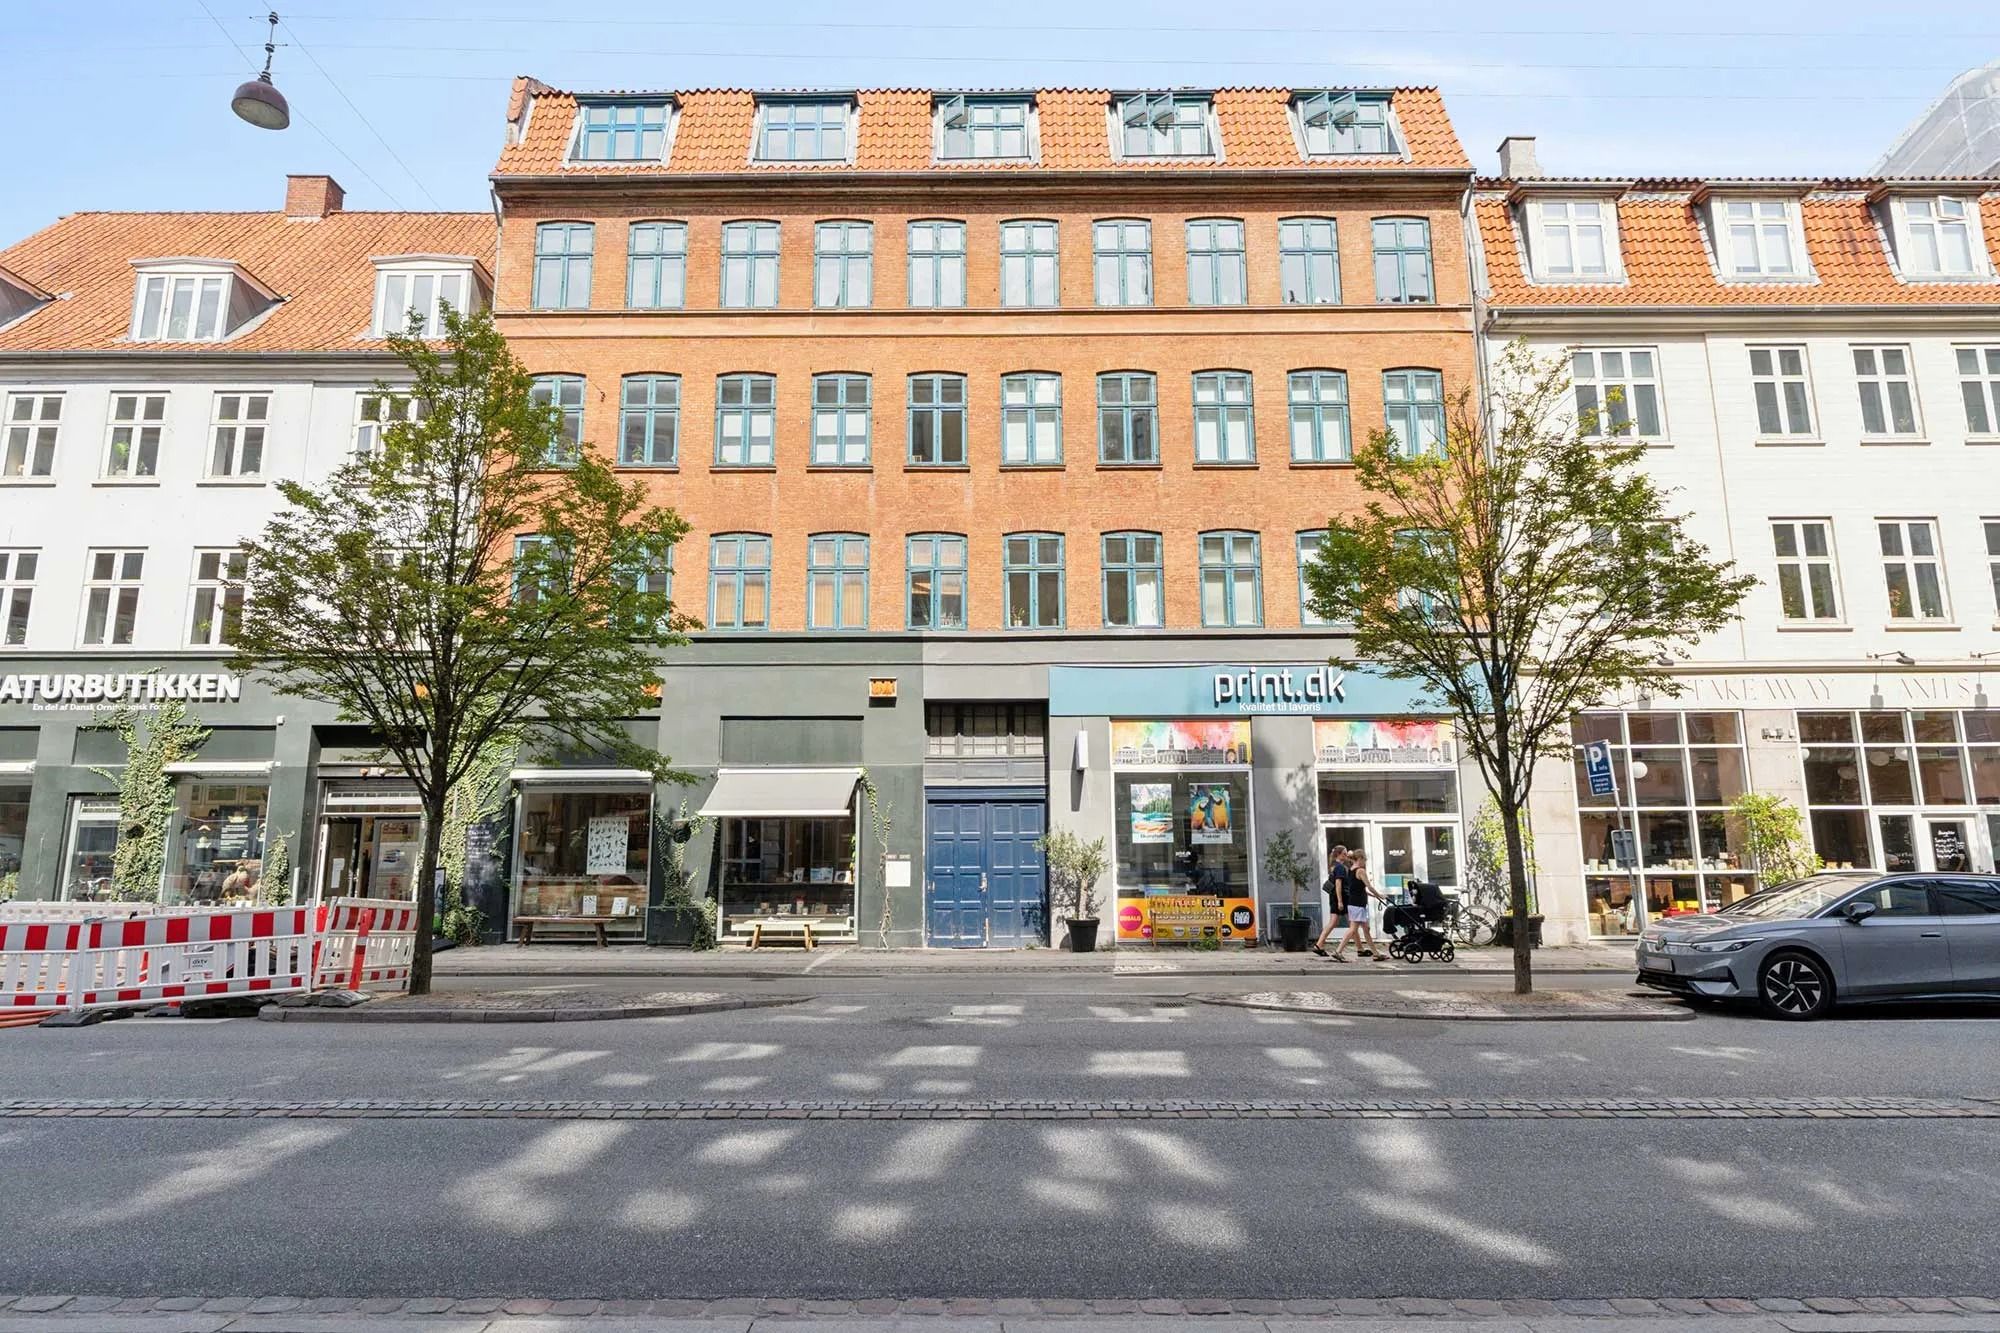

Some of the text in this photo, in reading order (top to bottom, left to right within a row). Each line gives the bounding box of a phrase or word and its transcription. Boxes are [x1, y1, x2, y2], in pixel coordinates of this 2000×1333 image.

[0, 674, 240, 699] ATURBUTIKKEN
[1214, 666, 1346, 702] print.dk
[32, 703, 43, 711] En
[45, 703, 58, 711] del
[59, 703, 69, 711] af
[70, 703, 94, 711] Dansk
[1240, 702, 1321, 712] Kvalitet til lavpris
[1590, 746, 1602, 772] P
